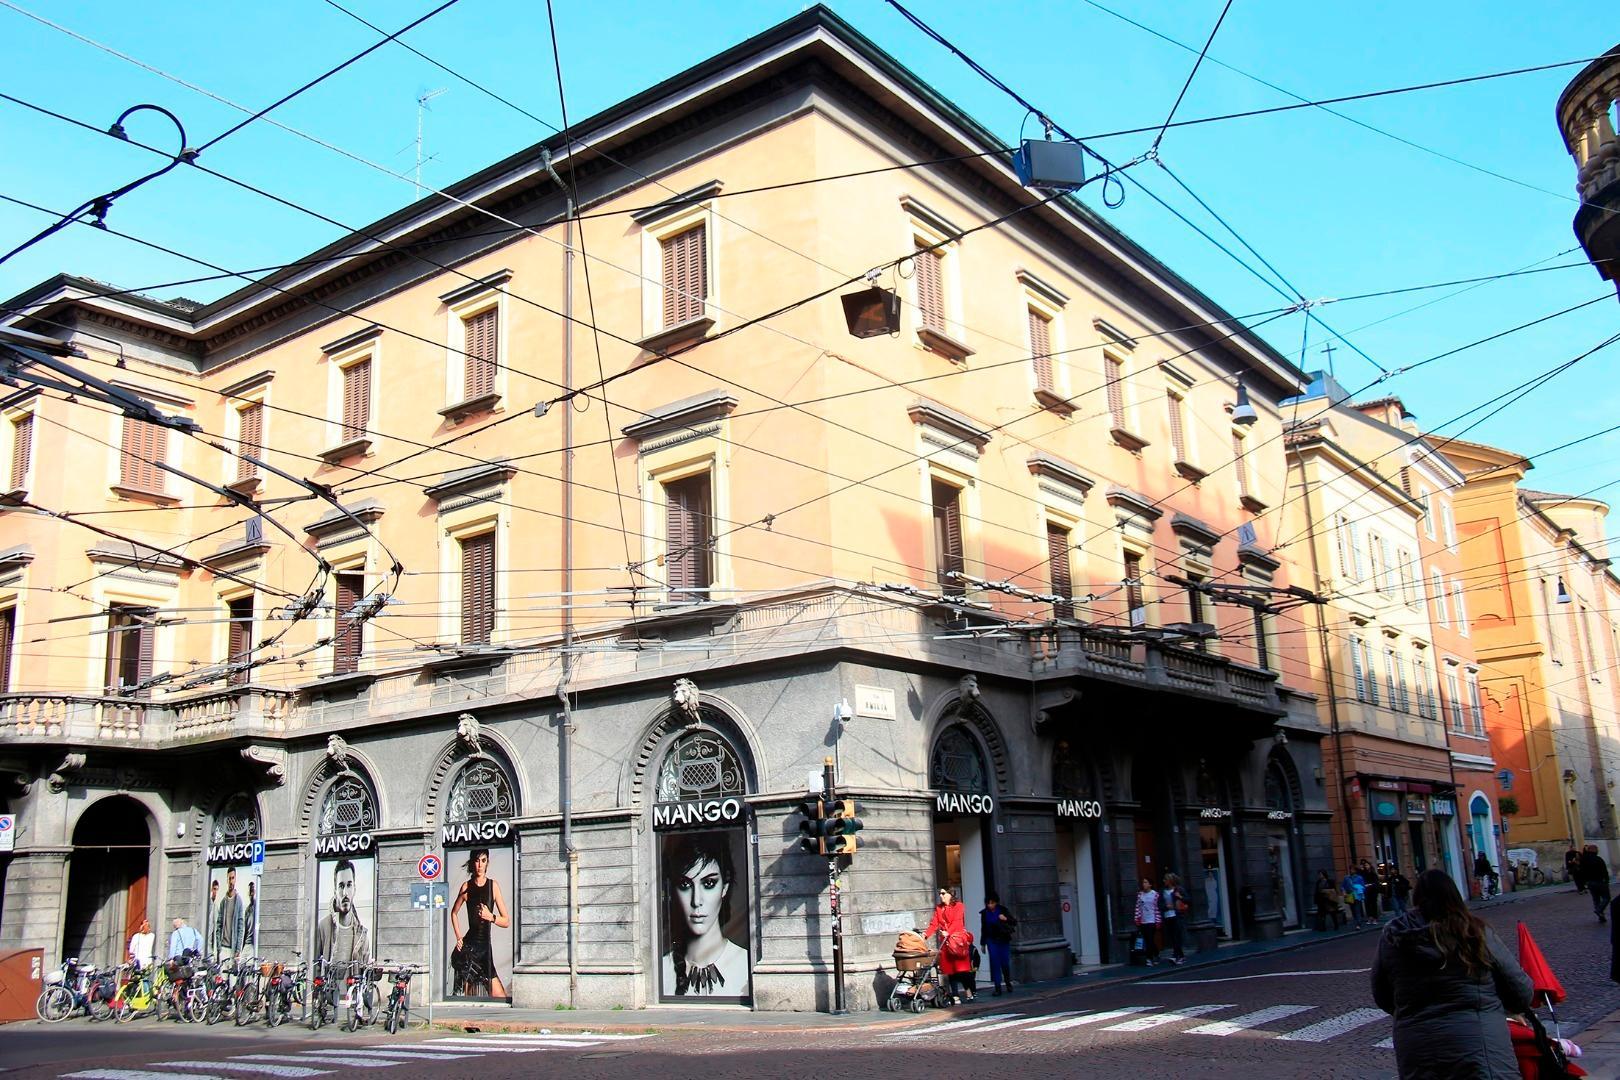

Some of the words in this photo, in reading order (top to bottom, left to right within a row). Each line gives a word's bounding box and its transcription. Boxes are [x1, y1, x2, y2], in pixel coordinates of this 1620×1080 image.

[653, 798, 740, 826] MANGO
[936, 792, 994, 814] MANGO
[1057, 799, 1102, 818] MANGO
[1200, 807, 1222, 818] MANGO
[442, 820, 510, 843] MANGO
[206, 843, 253, 862] MANGO
[254, 843, 262, 862] P
[315, 833, 371, 854] MANGO
